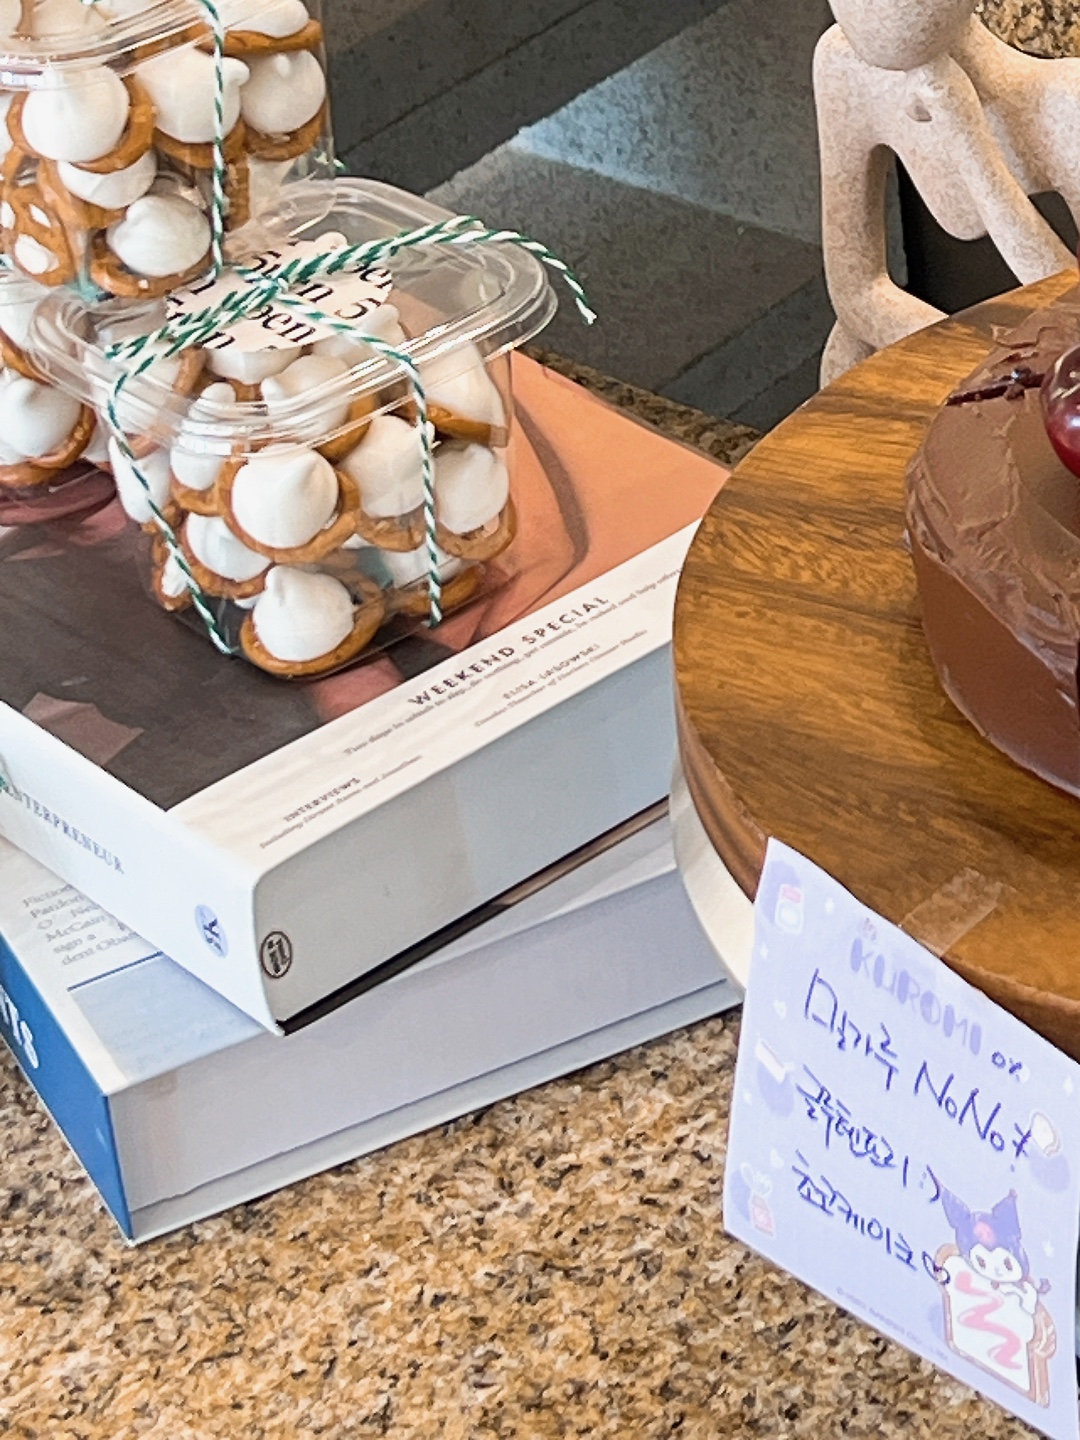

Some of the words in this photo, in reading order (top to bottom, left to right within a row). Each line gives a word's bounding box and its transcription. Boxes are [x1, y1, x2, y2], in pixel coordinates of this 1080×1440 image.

[407, 646, 516, 707] WEEKEND
[521, 594, 610, 646] SPECIAL
[851, 938, 982, 1056] KUROMI
